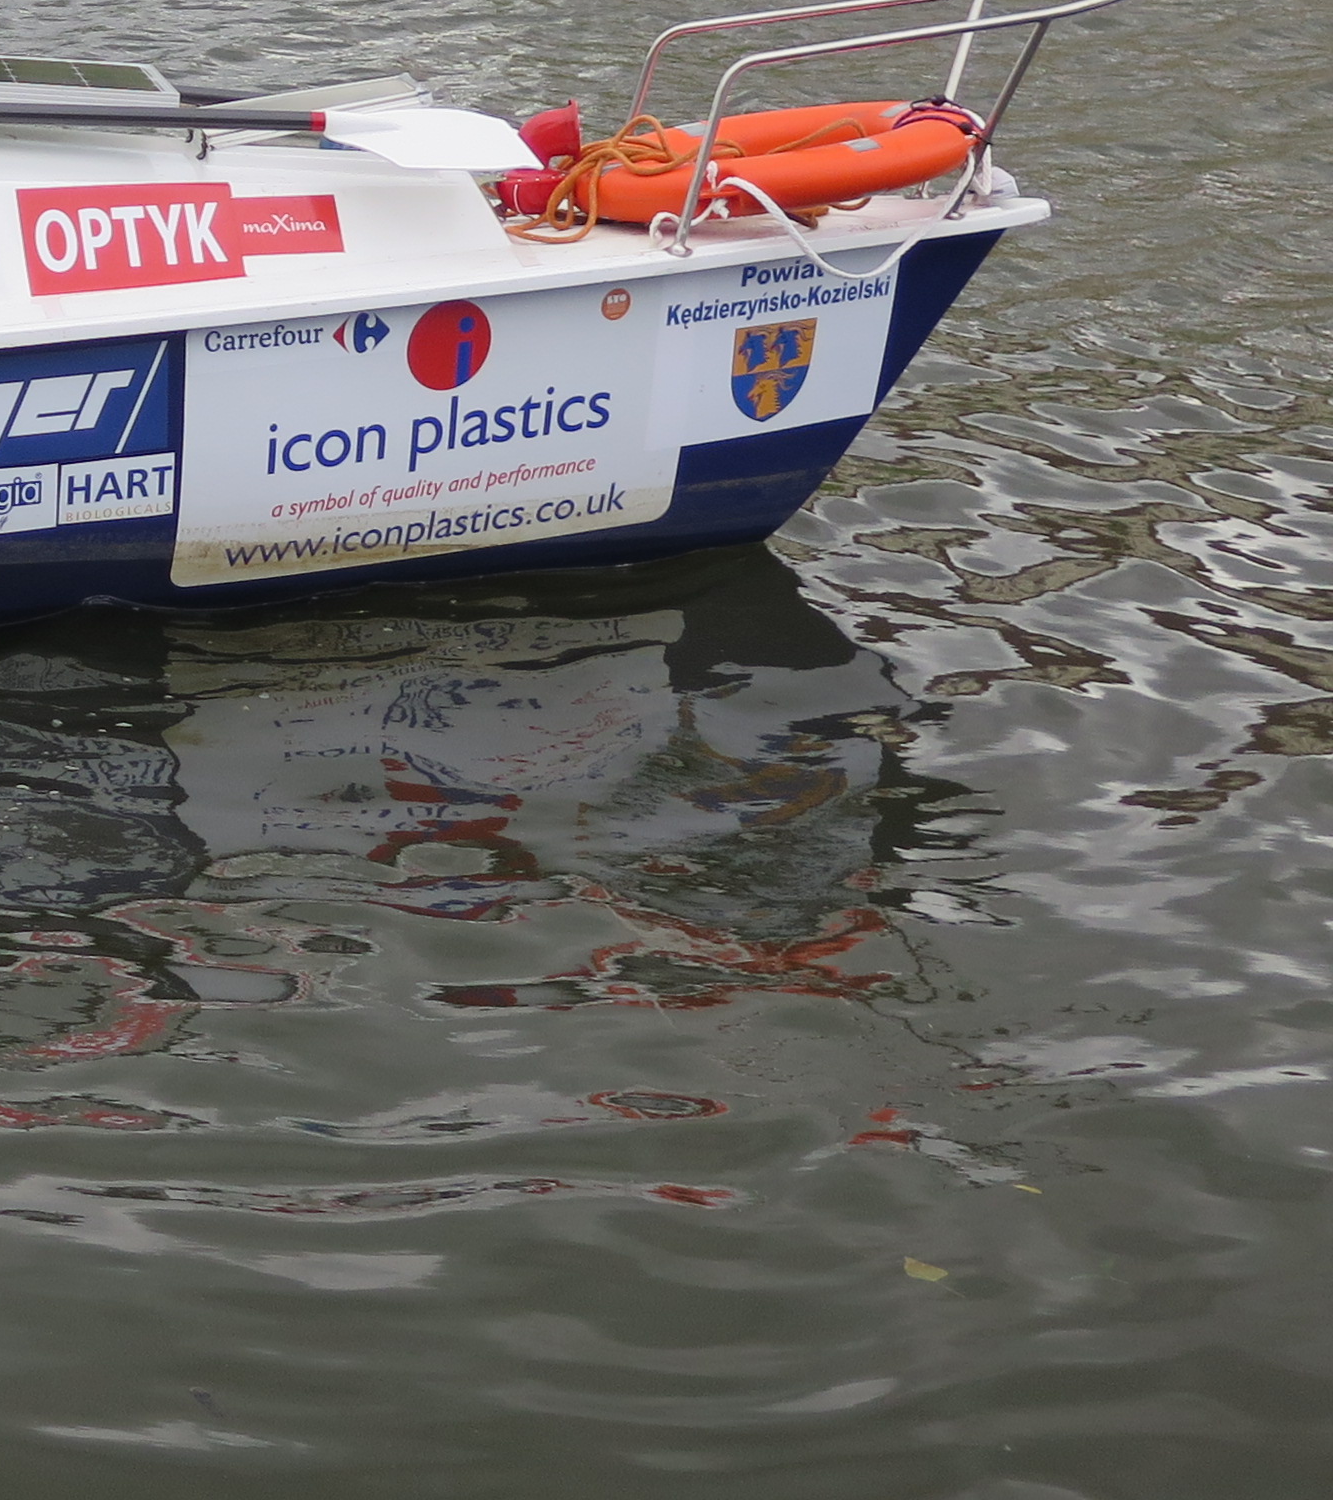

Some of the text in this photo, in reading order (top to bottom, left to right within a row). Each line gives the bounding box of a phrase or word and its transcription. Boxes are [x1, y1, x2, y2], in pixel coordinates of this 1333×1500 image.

[35, 201, 228, 273] OPTYK
[740, 261, 825, 288] Powiat
[666, 275, 891, 330] Kędzierzyńsko-Kozielski
[204, 322, 324, 353] Carrefour
[265, 386, 611, 475] icon plastics
[65, 502, 173, 523] BIOLOGICALS
[67, 465, 173, 506] HART
[271, 454, 597, 519] a symbol of quality and performance
[225, 482, 626, 567] www.iconplastics.co.uk
